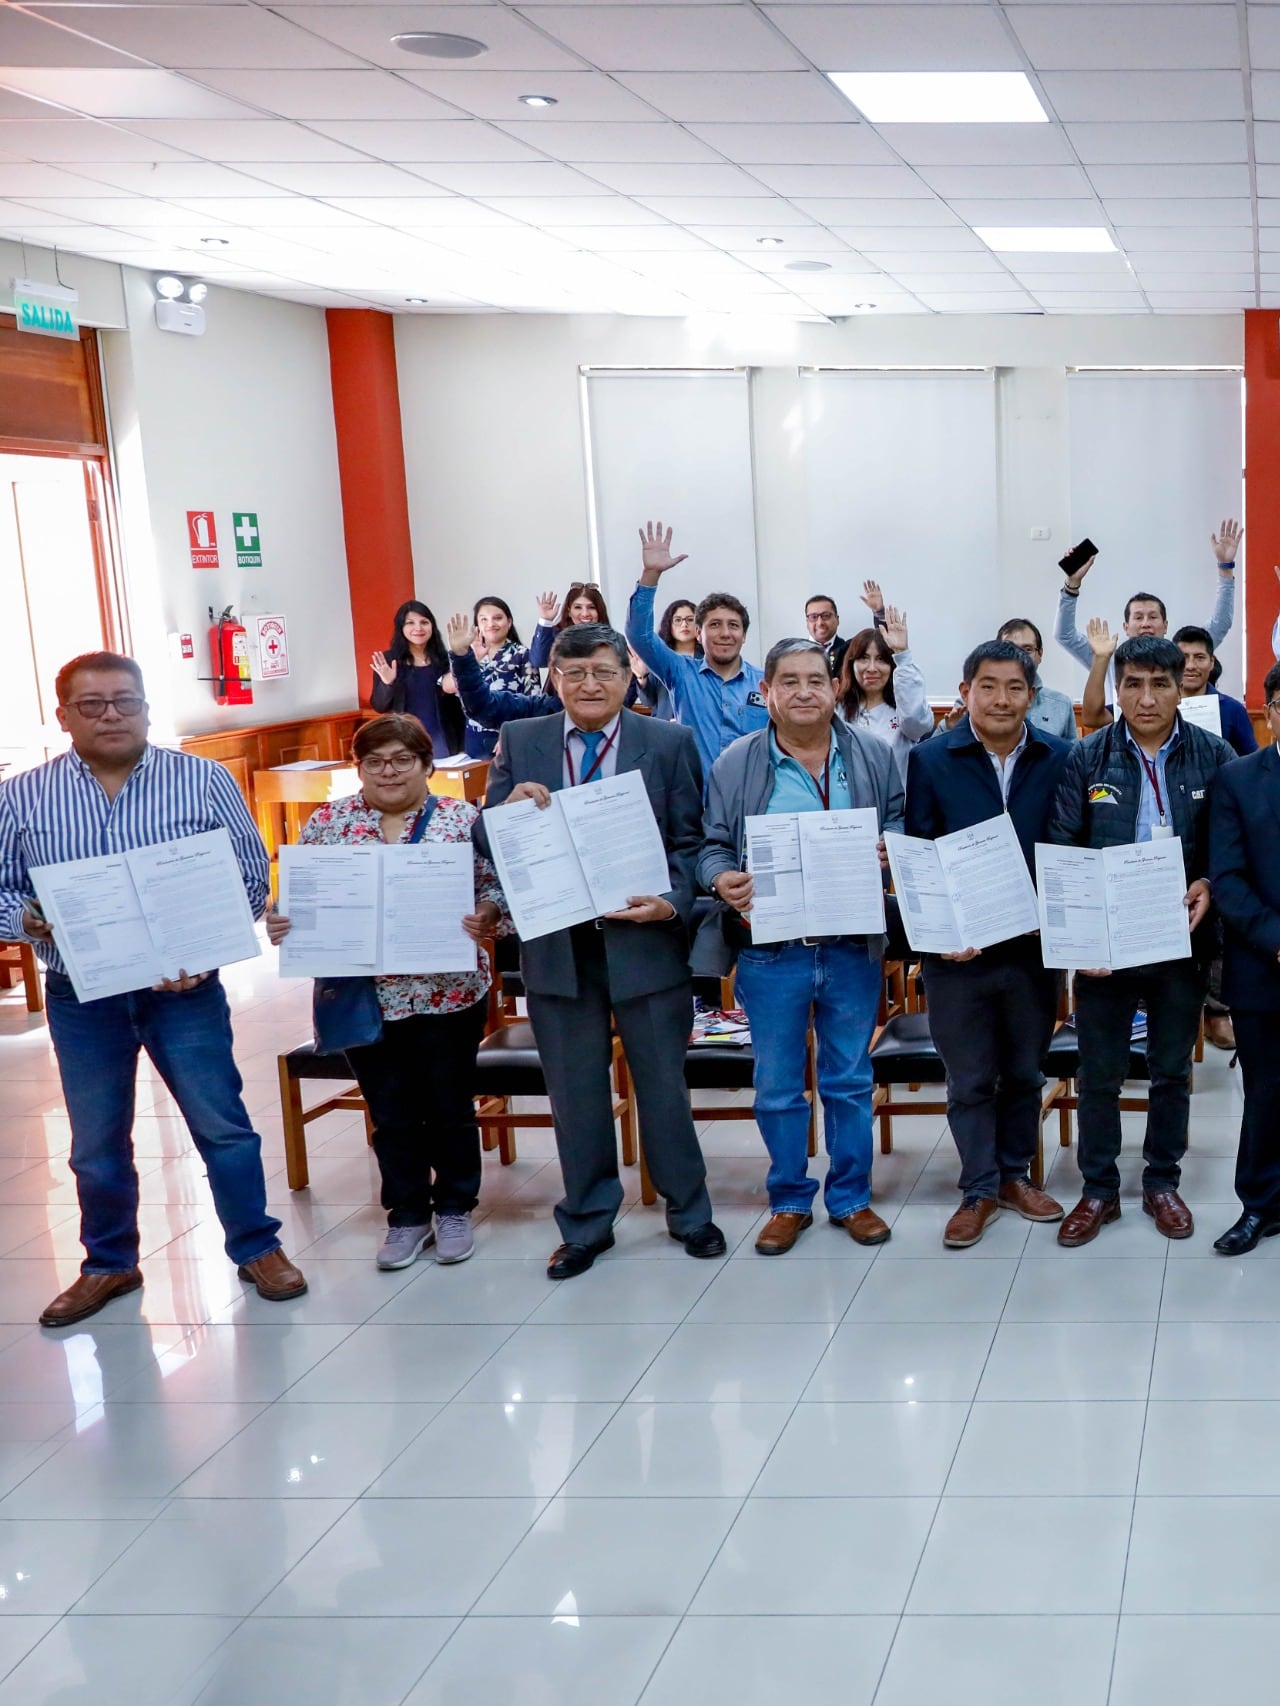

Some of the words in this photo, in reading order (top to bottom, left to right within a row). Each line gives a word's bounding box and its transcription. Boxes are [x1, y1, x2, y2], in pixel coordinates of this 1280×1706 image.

[22, 303, 74, 333] SALIDA
[192, 555, 218, 564] EXTINTOR
[1191, 790, 1205, 799] CAT
